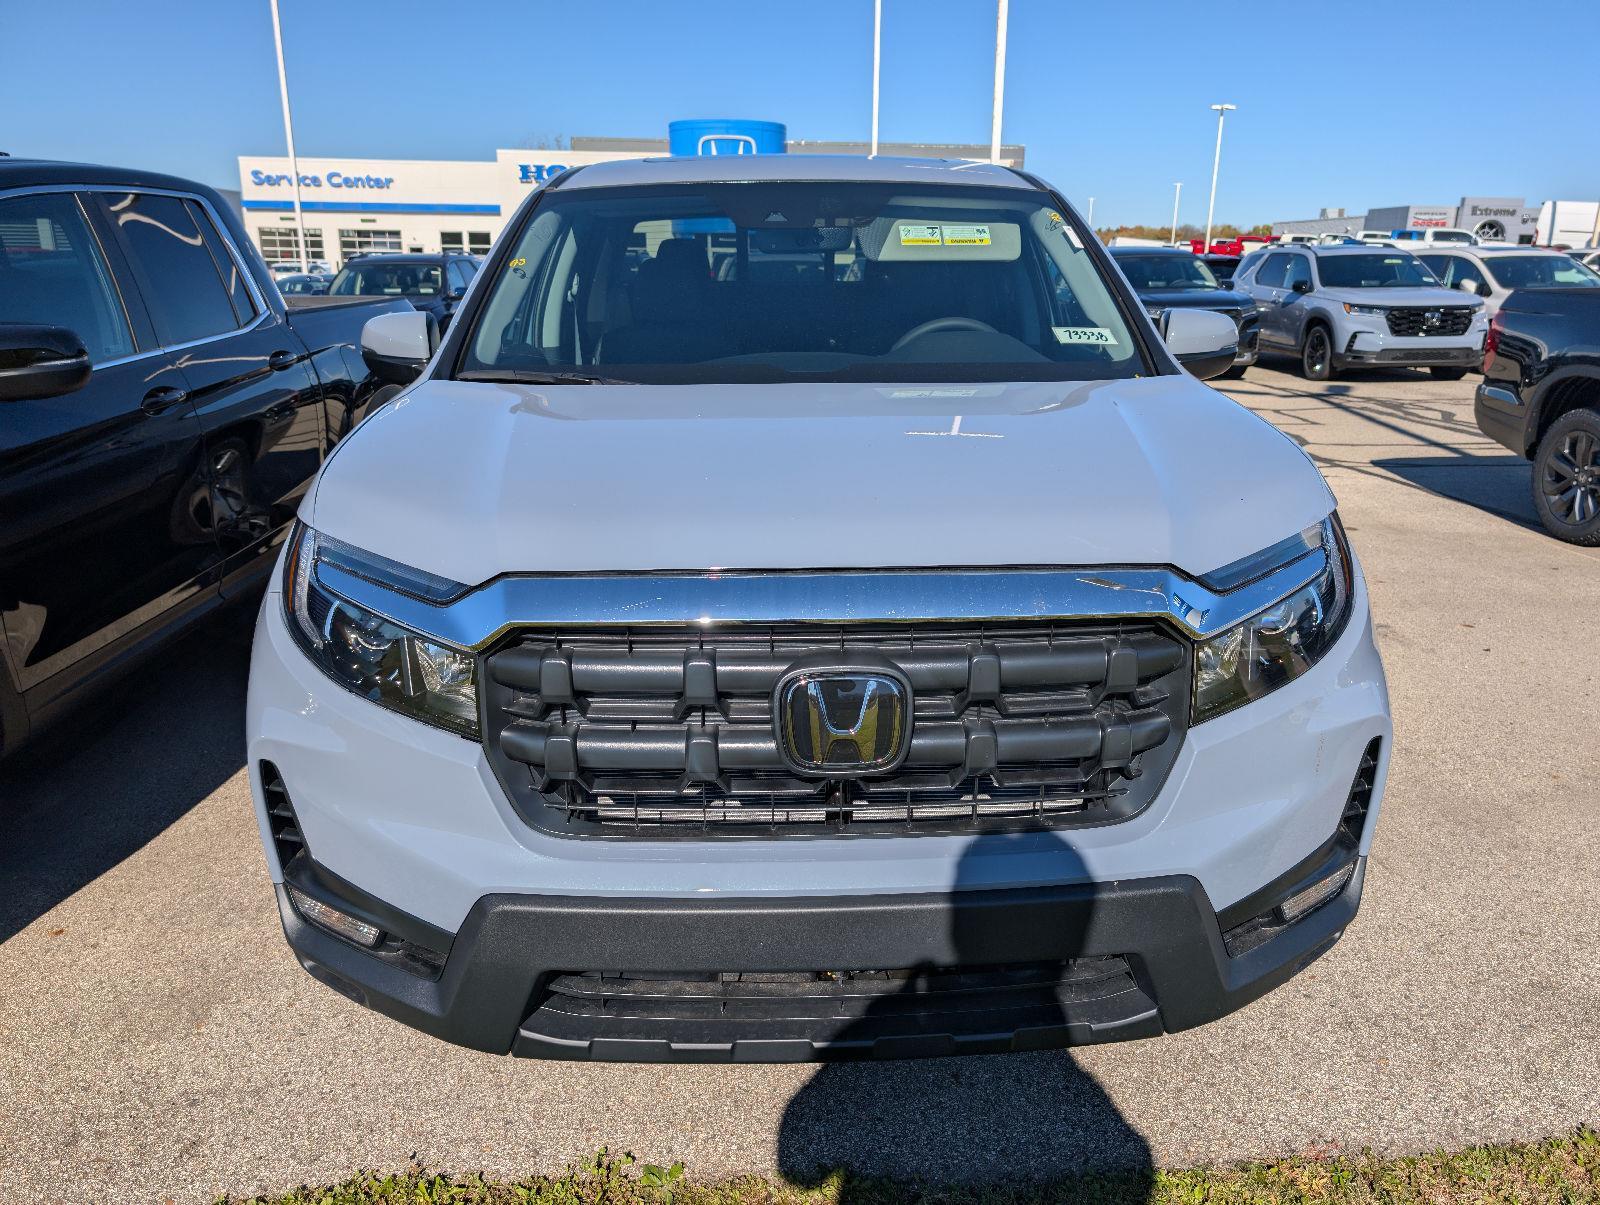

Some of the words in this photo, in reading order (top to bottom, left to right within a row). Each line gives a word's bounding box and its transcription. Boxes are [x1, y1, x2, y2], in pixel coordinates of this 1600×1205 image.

[251, 169, 322, 187] Servce
[326, 171, 394, 189] Center
[1471, 206, 1516, 216] Extreme
[1063, 330, 1108, 342] 73338
